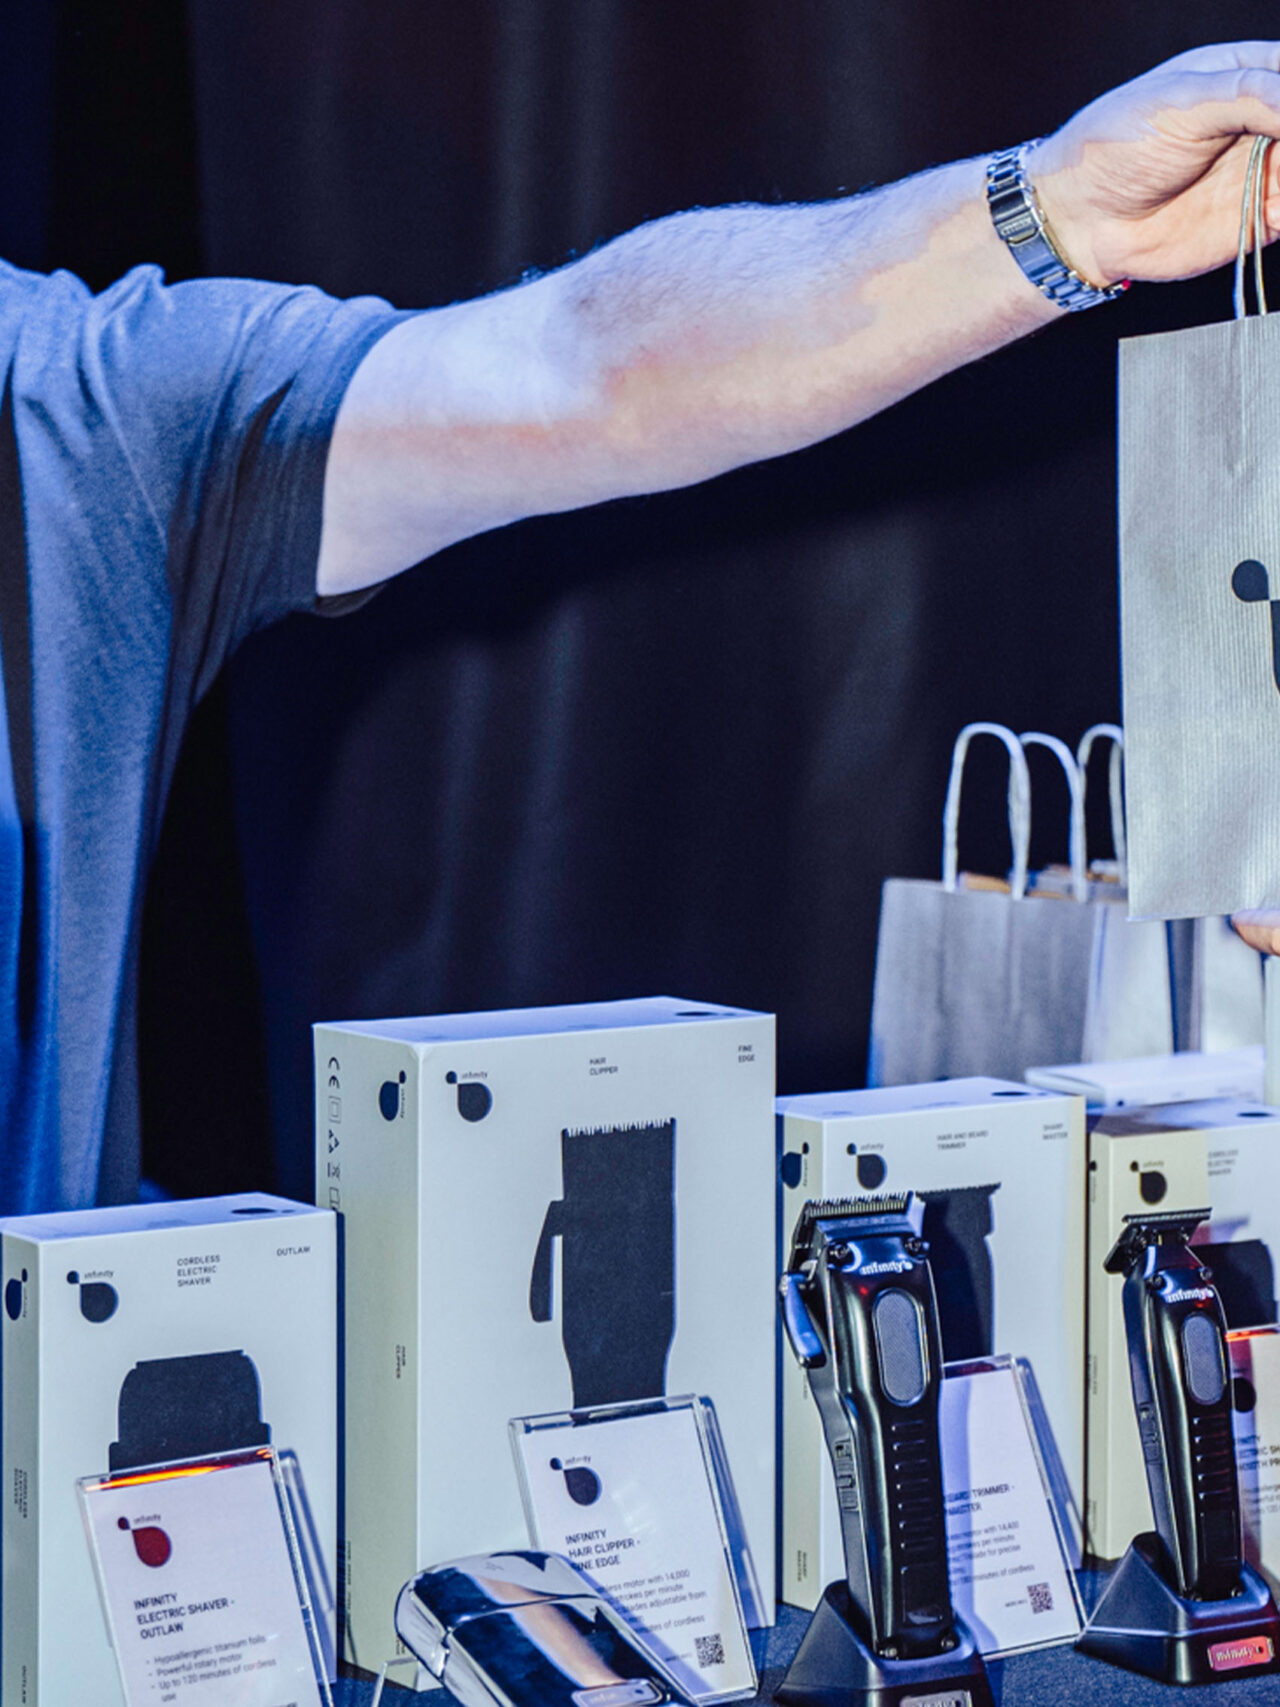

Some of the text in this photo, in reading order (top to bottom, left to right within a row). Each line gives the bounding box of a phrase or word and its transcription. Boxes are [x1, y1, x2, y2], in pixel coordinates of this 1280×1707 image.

[276, 1246, 311, 1257] OUTLAW
[177, 1254, 221, 1266] CORDLESS
[177, 1265, 217, 1277] ELECTRIC
[177, 1276, 212, 1288] SHAVER
[972, 1483, 1010, 1498] TRIMMER
[565, 1529, 607, 1545] INFINITY
[568, 1545, 592, 1559] HAIR
[594, 1538, 635, 1554] CLIPPER
[595, 1555, 621, 1569] EDGE
[134, 1593, 179, 1610] INFINITY
[137, 1605, 186, 1626] ELECTRIC
[188, 1597, 230, 1616] SHAVER
[140, 1622, 184, 1640] OUTLAW
[156, 1662, 193, 1677] Powerful
